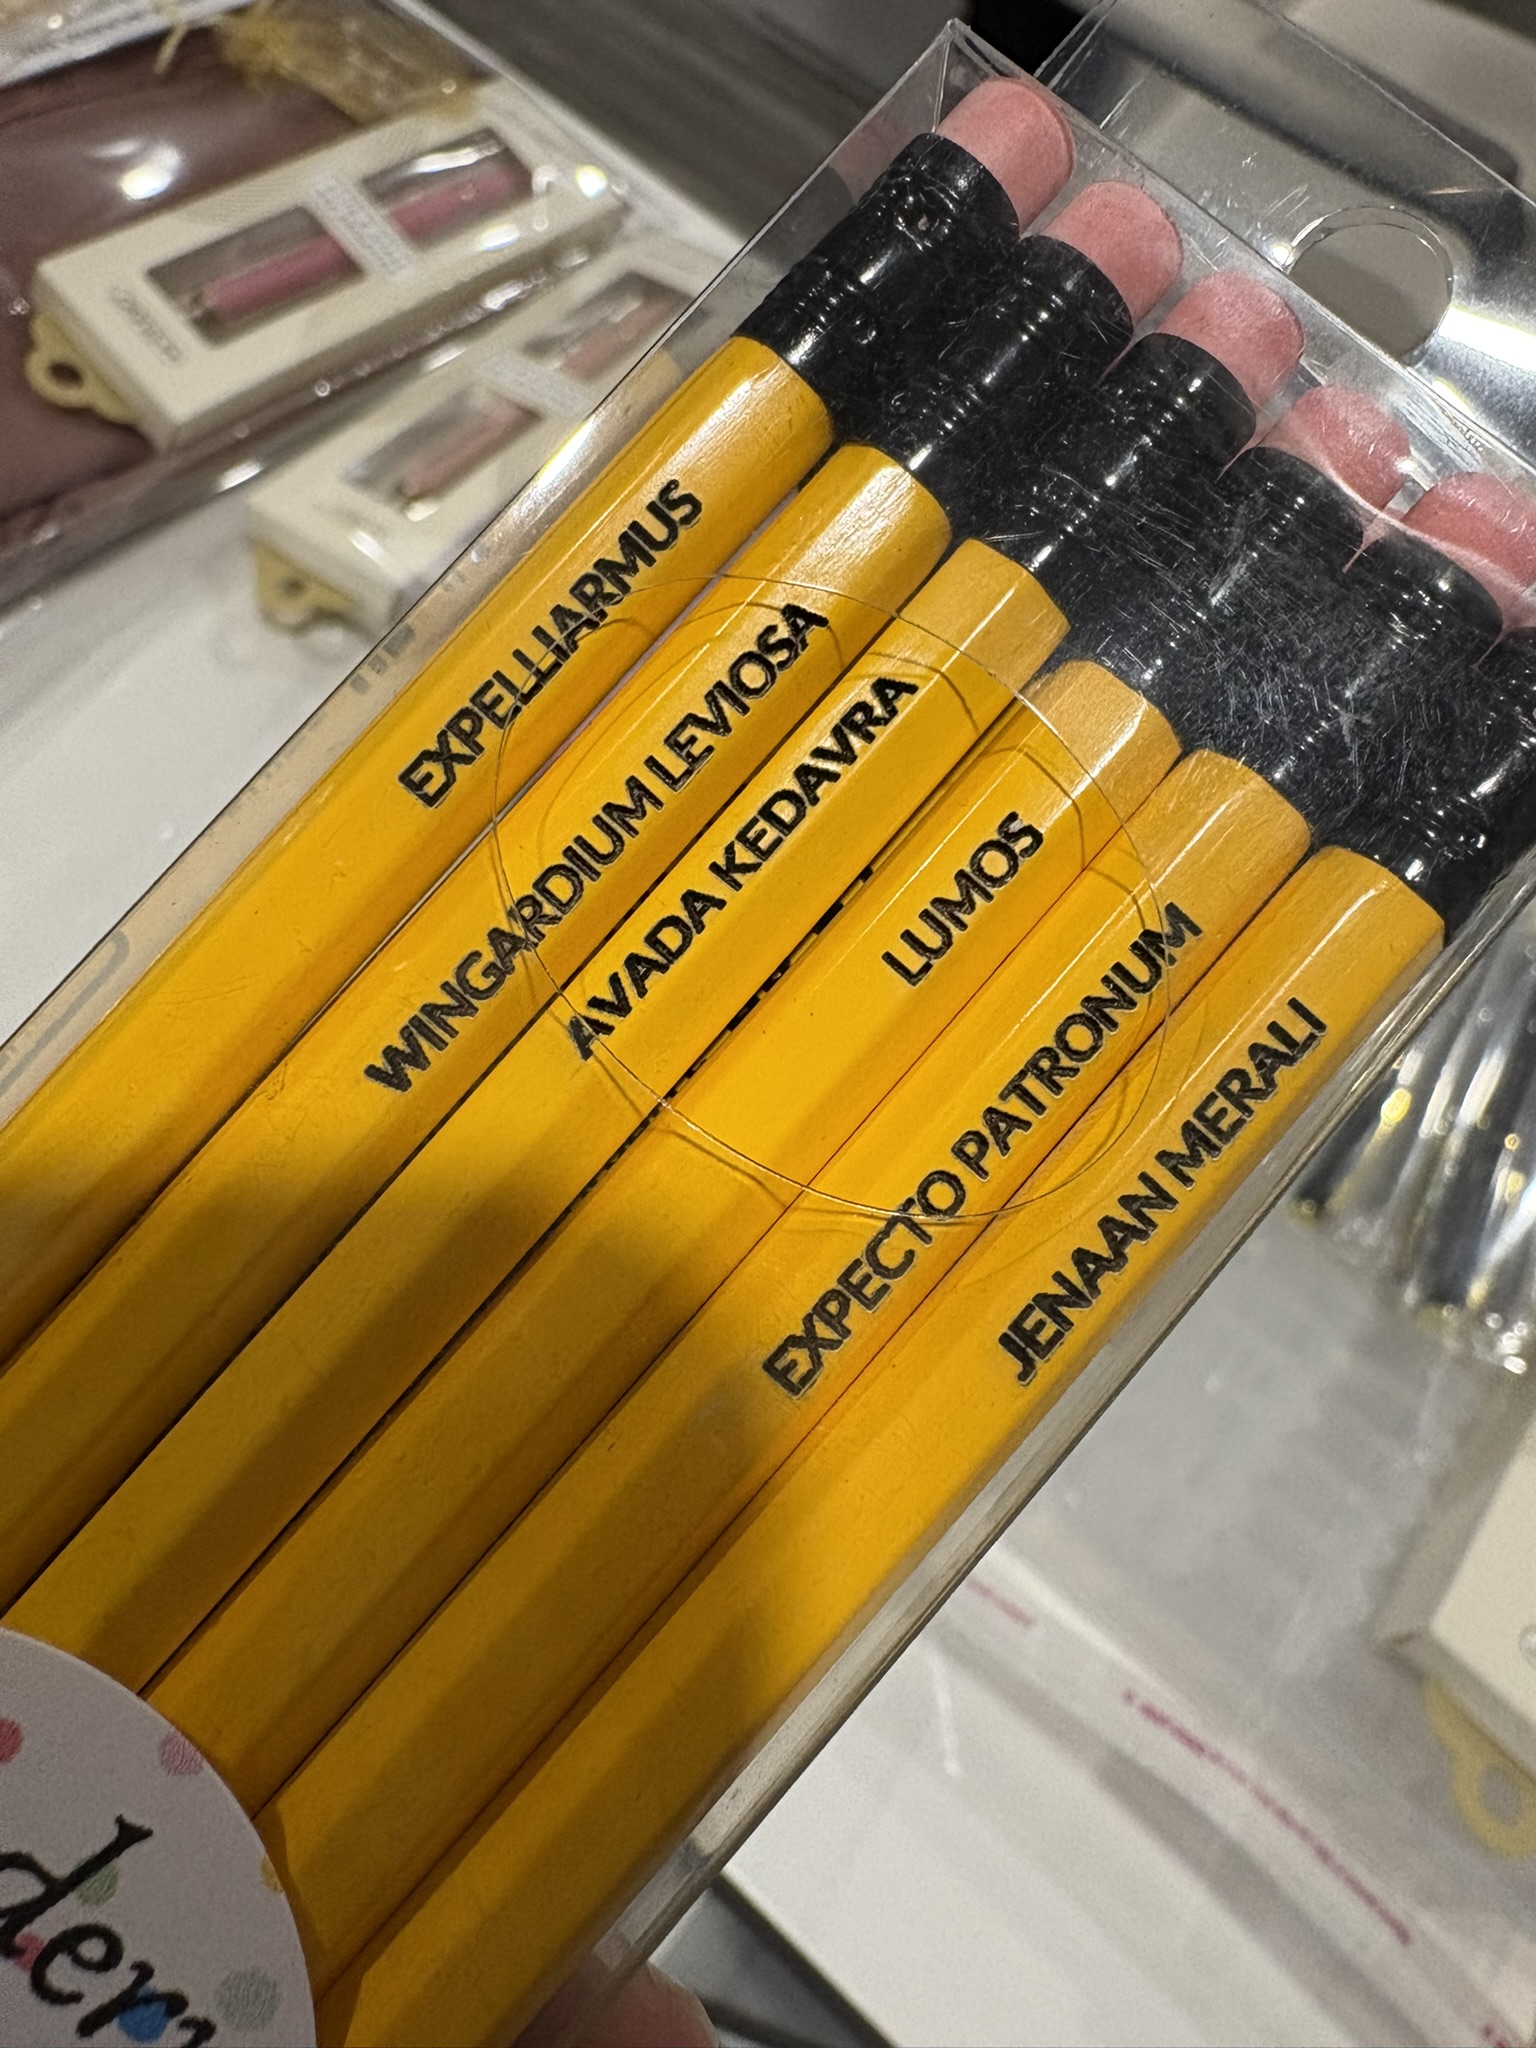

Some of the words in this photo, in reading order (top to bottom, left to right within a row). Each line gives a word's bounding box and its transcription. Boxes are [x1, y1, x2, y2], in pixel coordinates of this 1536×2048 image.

[397, 479, 703, 808] EXPELLIARMUS
[364, 775, 663, 1094] WINGARDIUM
[643, 603, 829, 793] LEVIOSA
[567, 888, 727, 1061] AVADA
[709, 676, 919, 892] KEDAVRA
[881, 812, 1044, 986] LUMOS
[762, 1169, 966, 1398] EXPECTO
[950, 901, 1203, 1181] PATRONUM
[998, 1172, 1179, 1385] JENAAN
[1155, 997, 1327, 1188] MERALI
